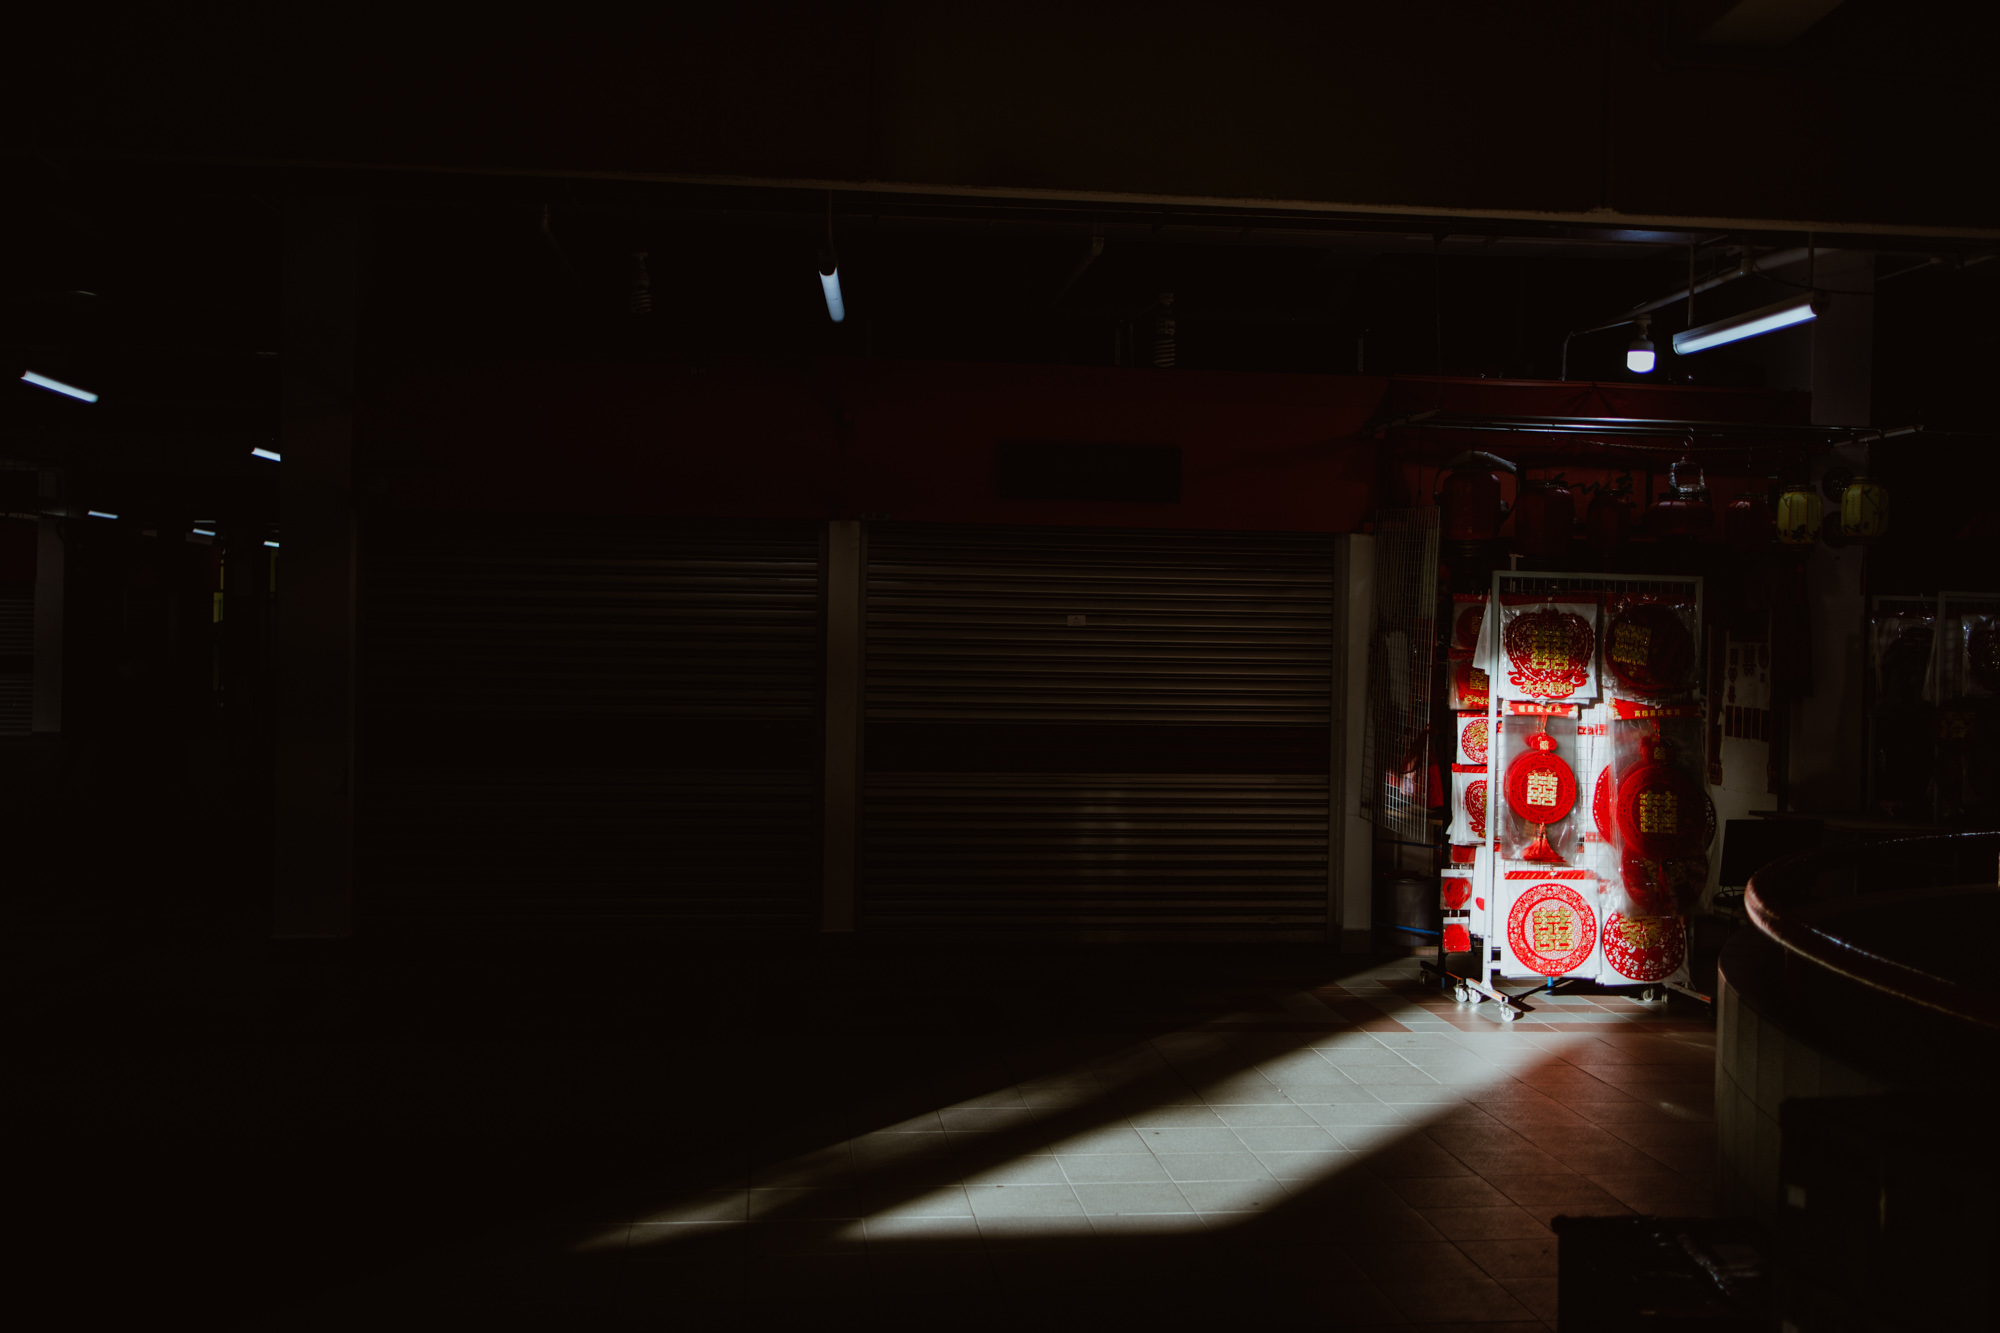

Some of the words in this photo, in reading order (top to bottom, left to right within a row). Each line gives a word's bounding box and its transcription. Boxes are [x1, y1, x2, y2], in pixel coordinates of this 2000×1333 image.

[1527, 771, 1558, 806] 囍
[1640, 790, 1678, 834] 囍
[1534, 907, 1574, 951] 囍
